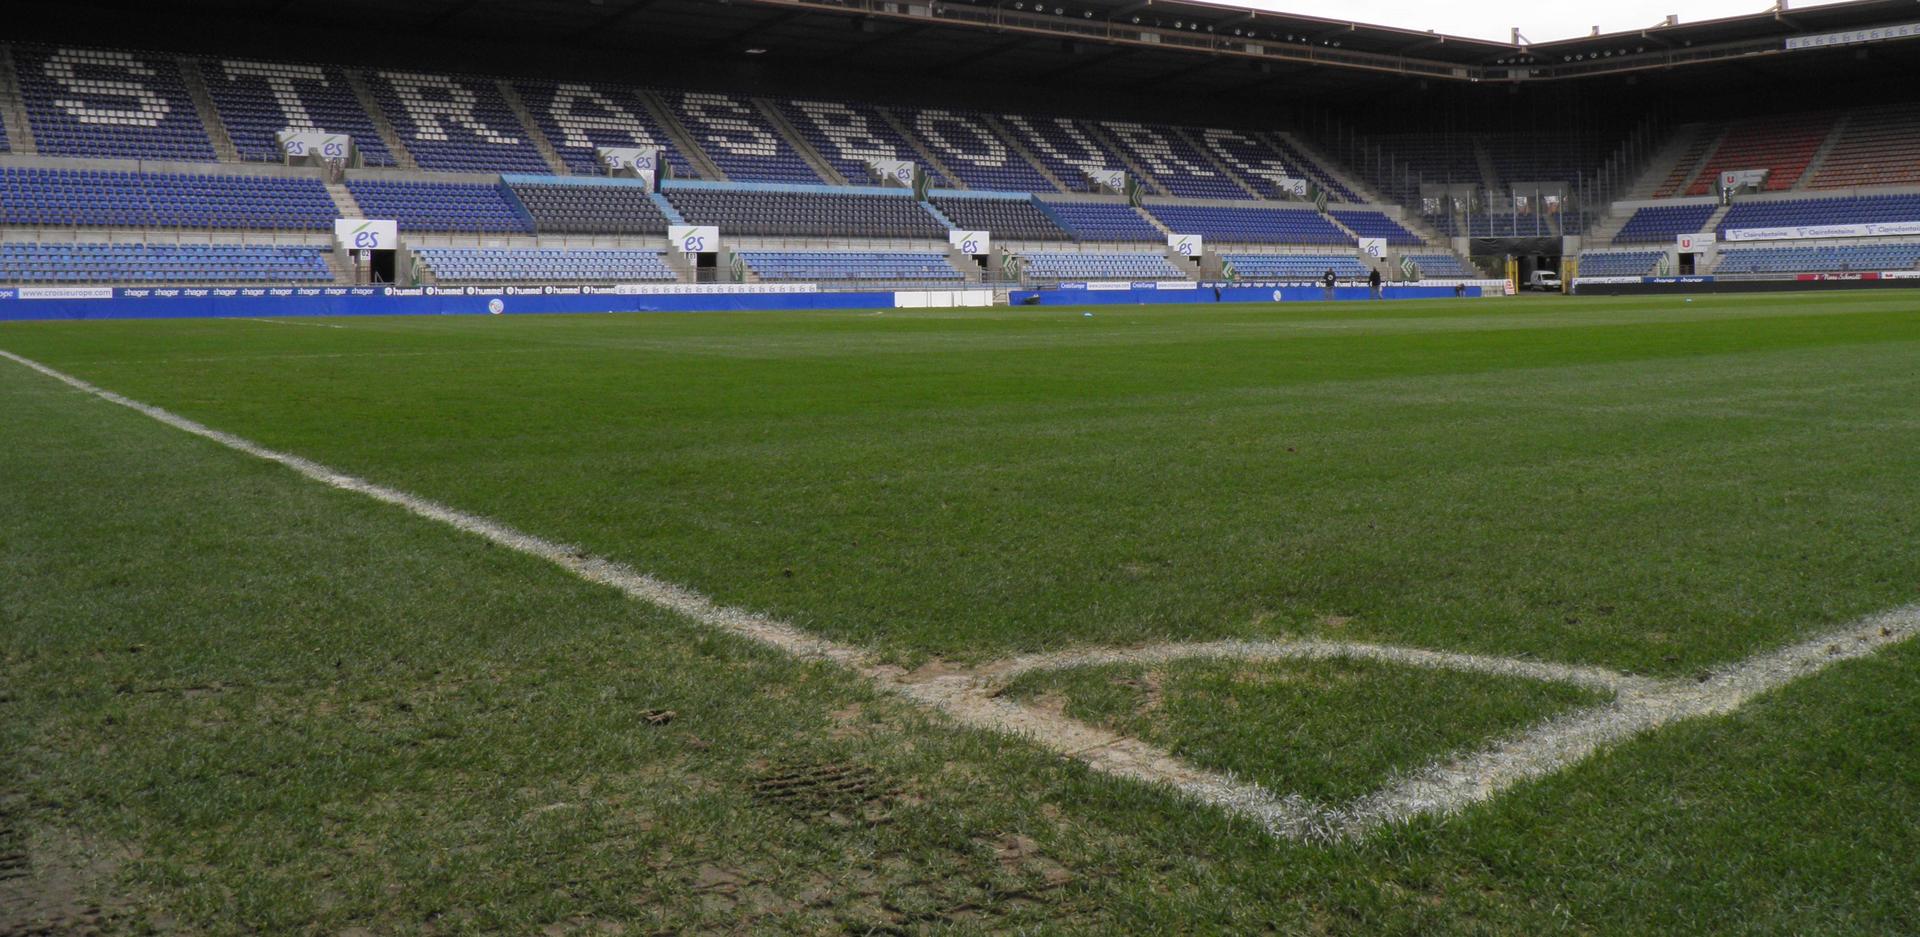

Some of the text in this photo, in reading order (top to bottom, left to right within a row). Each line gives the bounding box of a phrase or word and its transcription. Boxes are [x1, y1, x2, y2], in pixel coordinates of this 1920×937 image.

[23, 289, 112, 297] www.croisieurope.com
[393, 287, 423, 296] hummel
[435, 287, 464, 296] hummel
[475, 287, 503, 295] hummel
[515, 287, 542, 295] hummel
[553, 286, 580, 294] hummel
